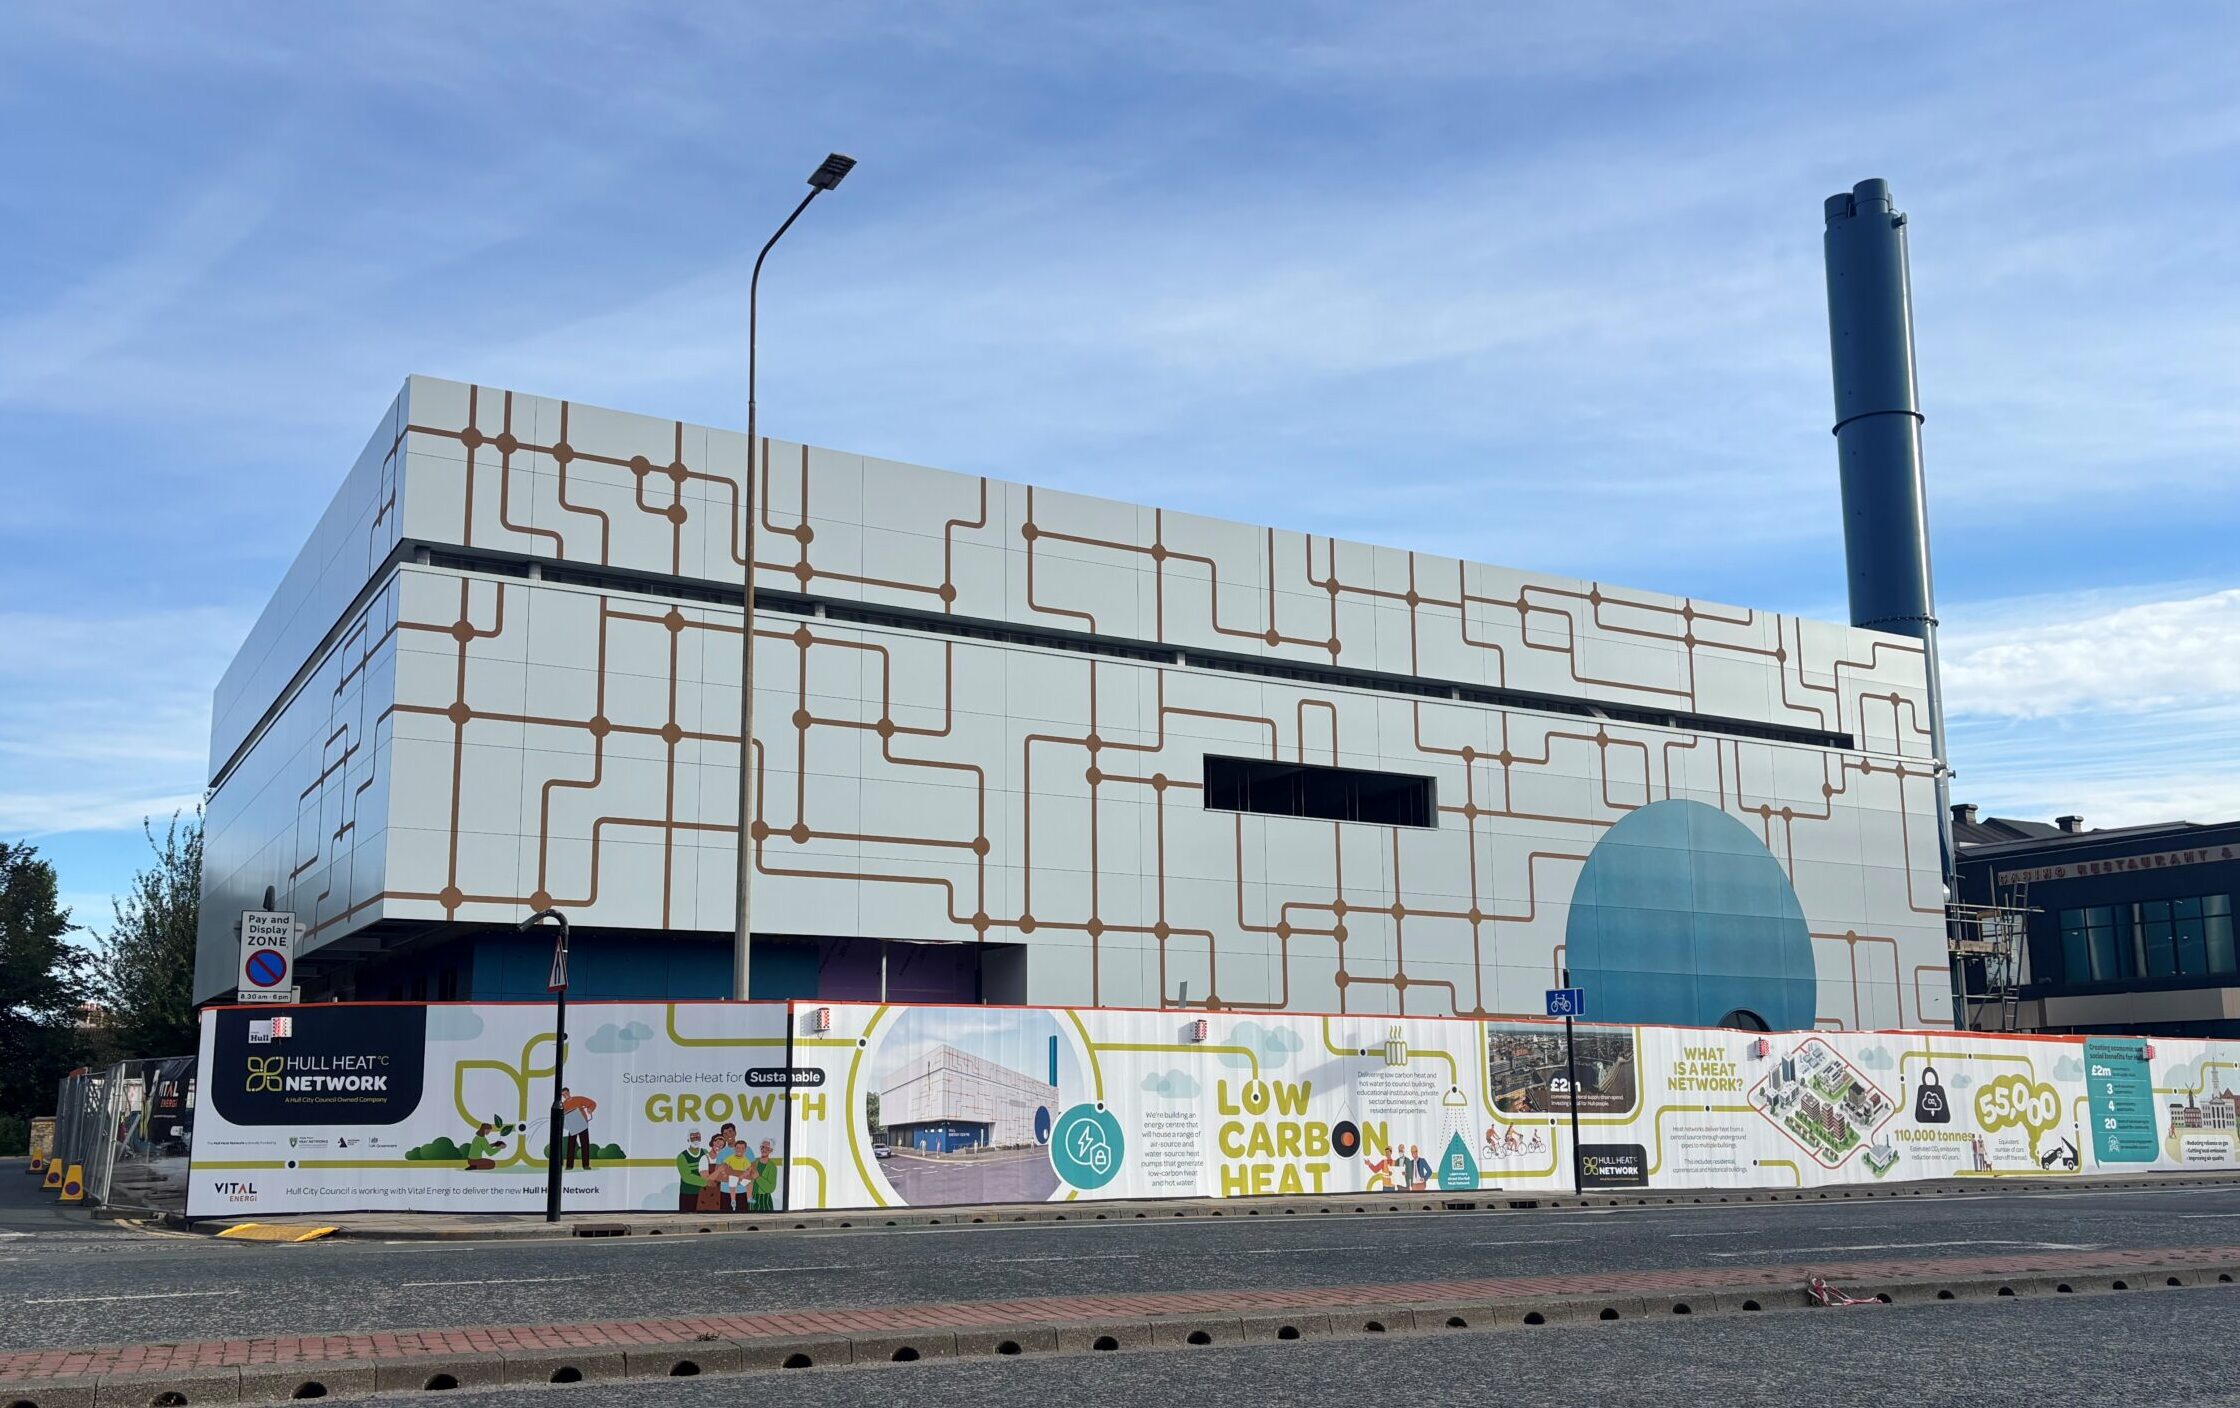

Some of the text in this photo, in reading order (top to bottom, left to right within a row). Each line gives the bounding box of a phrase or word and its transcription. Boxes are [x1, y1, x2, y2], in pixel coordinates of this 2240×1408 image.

[2077, 850, 2208, 876] RESTAURANT
[248, 914, 290, 924] Pay and
[250, 926, 288, 935] Display
[248, 936, 287, 946] ZONE
[250, 1034, 269, 1042] Hull
[1684, 1047, 1725, 1060] WHAT
[287, 1056, 329, 1070] HULL
[332, 1056, 376, 1070] HEAT
[1674, 1061, 1736, 1076] IS A HEAT
[2092, 1065, 2111, 1076] £2m
[286, 1076, 387, 1091] NETWORK
[623, 1072, 820, 1084] Sustainable Heat for Sustanable
[1667, 1077, 1743, 1091] NETWORK?
[2106, 1083, 2113, 1094] 3
[1217, 1079, 1312, 1116] LOW
[1980, 1082, 2056, 1126] 55,000
[2109, 1100, 2115, 1111] 4
[1164, 1112, 1188, 1120] building
[2104, 1118, 2117, 1129] 20
[1894, 1129, 1973, 1142] 110,000 tonnes
[1599, 1167, 1638, 1175] NETWORK
[1220, 1163, 1331, 1198] HEAT
[215, 1182, 258, 1194] VITAL
[286, 1187, 301, 1195] Hull
[302, 1187, 318, 1196] City
[320, 1187, 350, 1195] Council
[358, 1187, 388, 1196] working
[390, 1187, 406, 1195] with
[427, 1187, 450, 1196] Energi
[562, 1186, 600, 1194] Network
